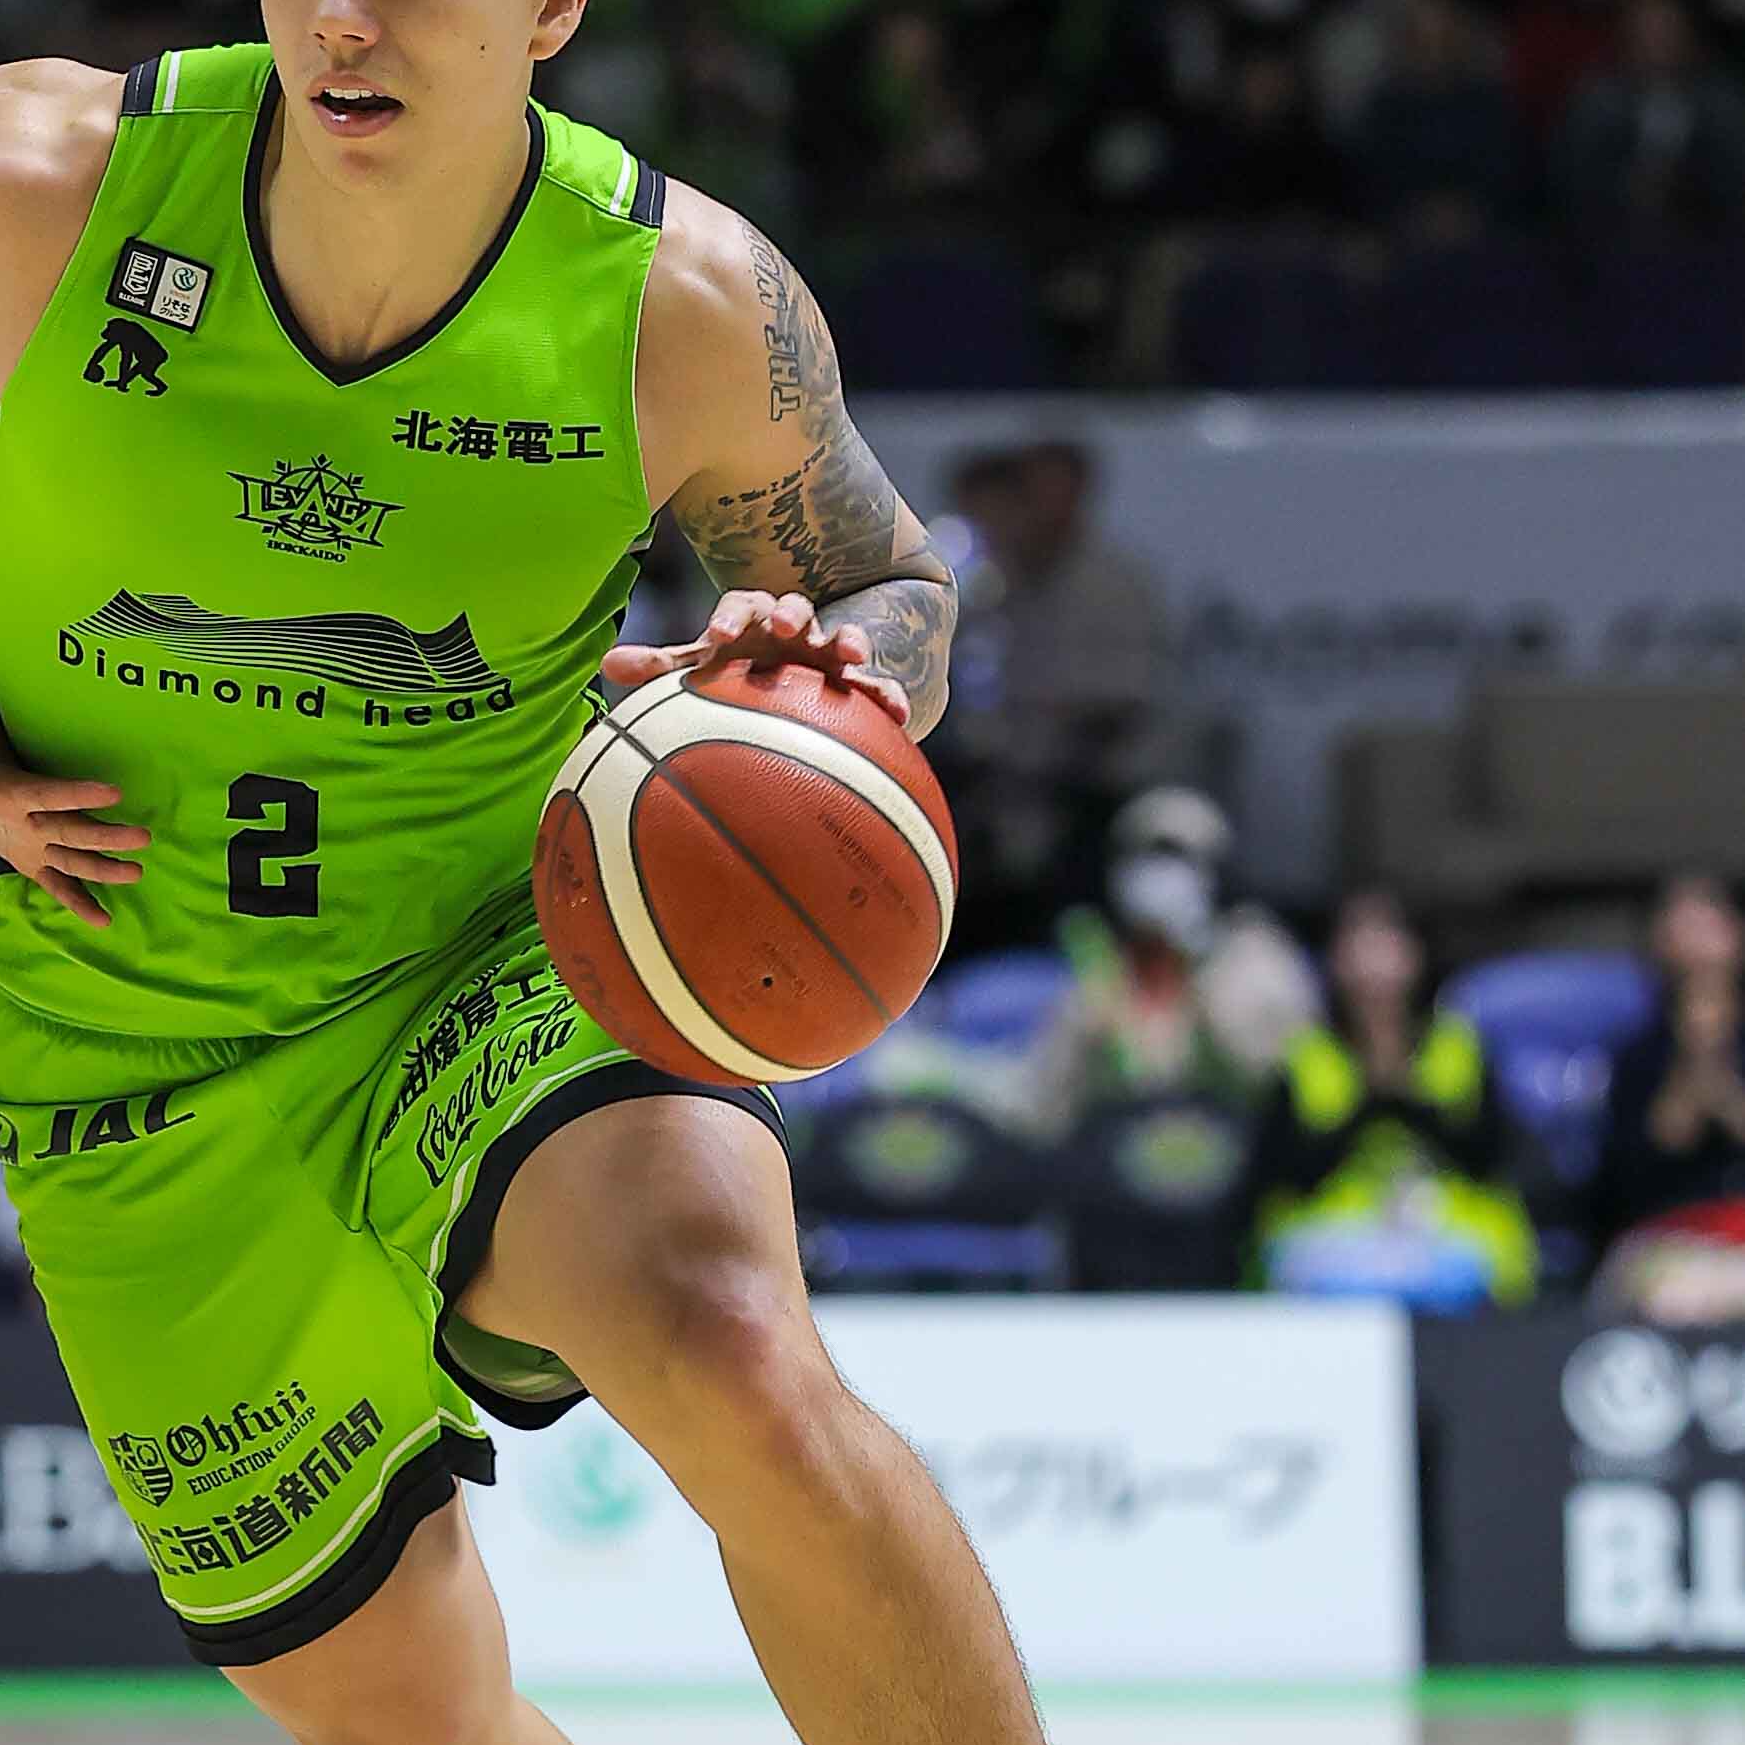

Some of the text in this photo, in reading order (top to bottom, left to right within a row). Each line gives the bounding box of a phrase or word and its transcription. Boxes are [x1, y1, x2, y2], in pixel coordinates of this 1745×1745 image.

[393, 409, 605, 464] 北海電工
[226, 470, 406, 547] LEVANGA
[266, 539, 346, 563] HOKKAIDO
[59, 629, 516, 727] Diamond head
[227, 773, 322, 918] 2
[33, 1088, 196, 1160] JAL
[166, 1381, 307, 1467] Ohfuji
[187, 1405, 317, 1496] EDUCATION GROUP
